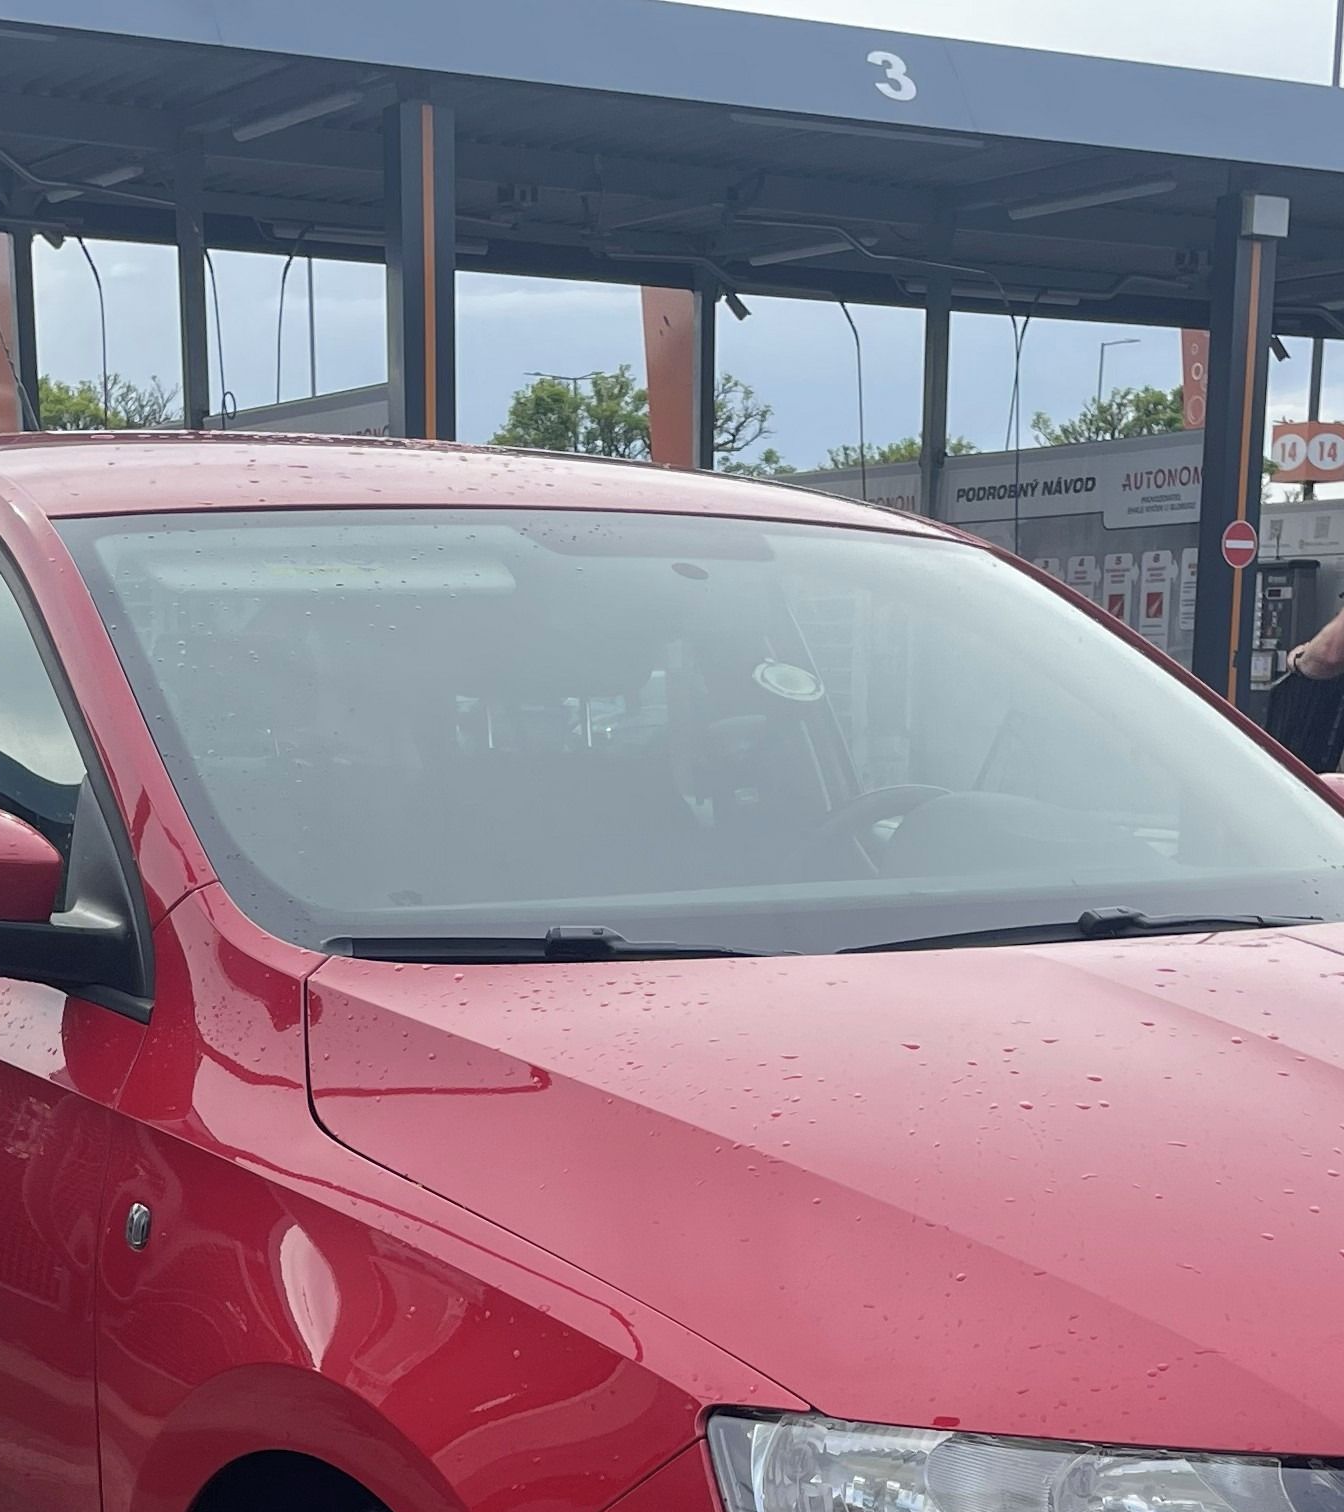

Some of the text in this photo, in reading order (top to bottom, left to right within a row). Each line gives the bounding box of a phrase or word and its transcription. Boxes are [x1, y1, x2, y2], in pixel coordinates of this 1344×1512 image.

[866, 50, 917, 101] 3
[1280, 441, 1297, 463] 14
[1319, 440, 1338, 462] 14
[955, 476, 1097, 503] PODROBNÝ NÁVOD
